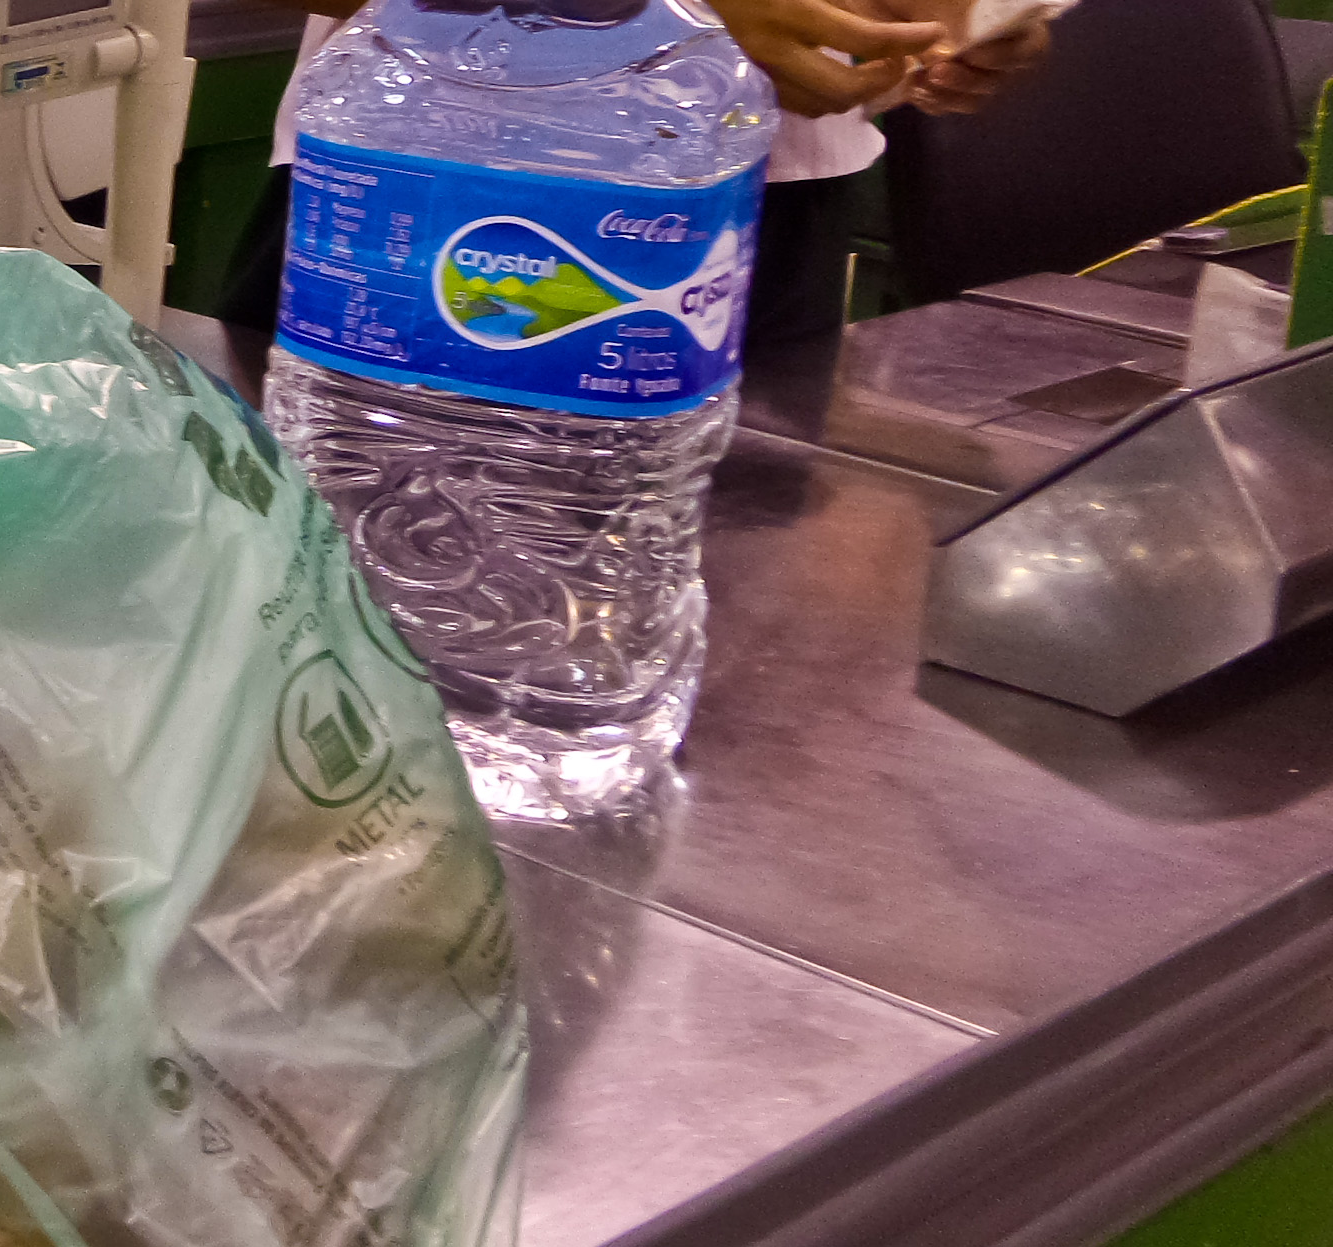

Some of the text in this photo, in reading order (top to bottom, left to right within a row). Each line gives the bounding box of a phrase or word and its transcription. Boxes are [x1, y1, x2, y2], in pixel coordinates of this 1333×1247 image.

[596, 208, 692, 243] Coca-Cola
[454, 247, 559, 279] crystal
[597, 341, 624, 370] 5
[335, 772, 425, 858] METAL
